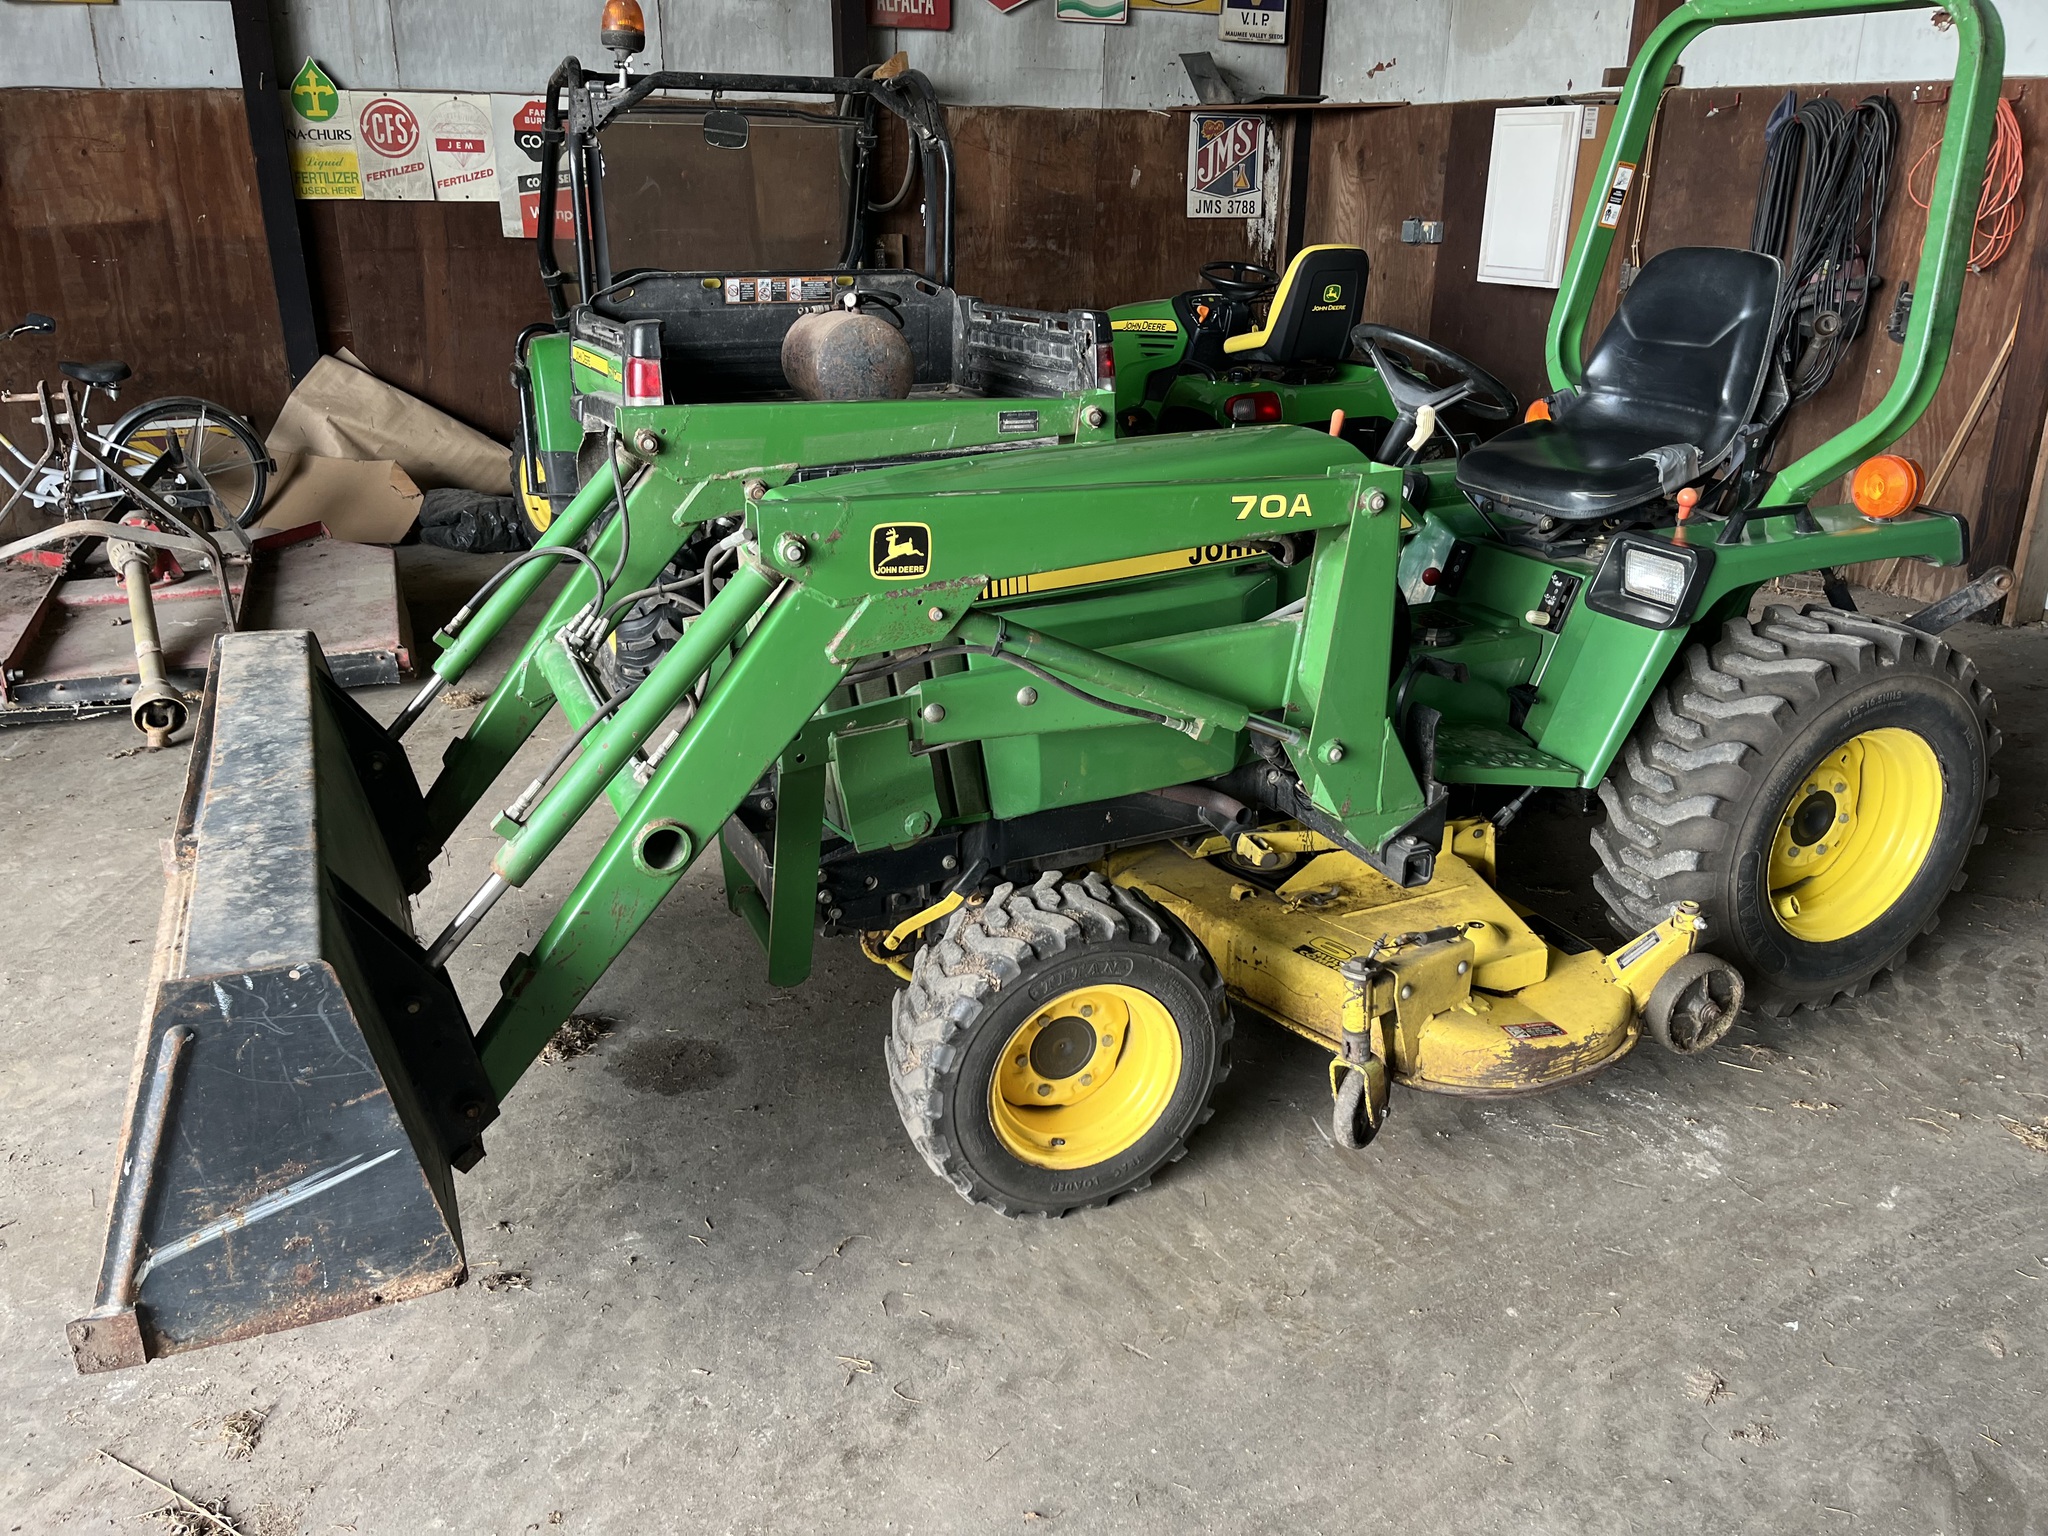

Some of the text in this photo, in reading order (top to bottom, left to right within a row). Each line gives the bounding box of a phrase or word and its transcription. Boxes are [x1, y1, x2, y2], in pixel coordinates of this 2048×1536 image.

[1225, 30, 1248, 38] MAUMEE
[528, 108, 546, 117] FAR
[371, 112, 408, 144] CFS
[520, 134, 545, 149] CO-
[1198, 120, 1253, 183] JMS
[305, 156, 345, 169] Liquid
[295, 171, 360, 184] FERTILIZER
[366, 162, 425, 182] FERTILIZED
[437, 168, 494, 189] FERTILIZED
[332, 186, 357, 195] HERE
[1195, 199, 1255, 214] JMS 3788
[1123, 321, 1167, 331] JOHN DEERE
[1231, 493, 1313, 521] 70A
[875, 565, 925, 575] JOHN DEERE
[1040, 960, 1122, 994] TITAN
[1050, 1176, 1101, 1193] LOADER
